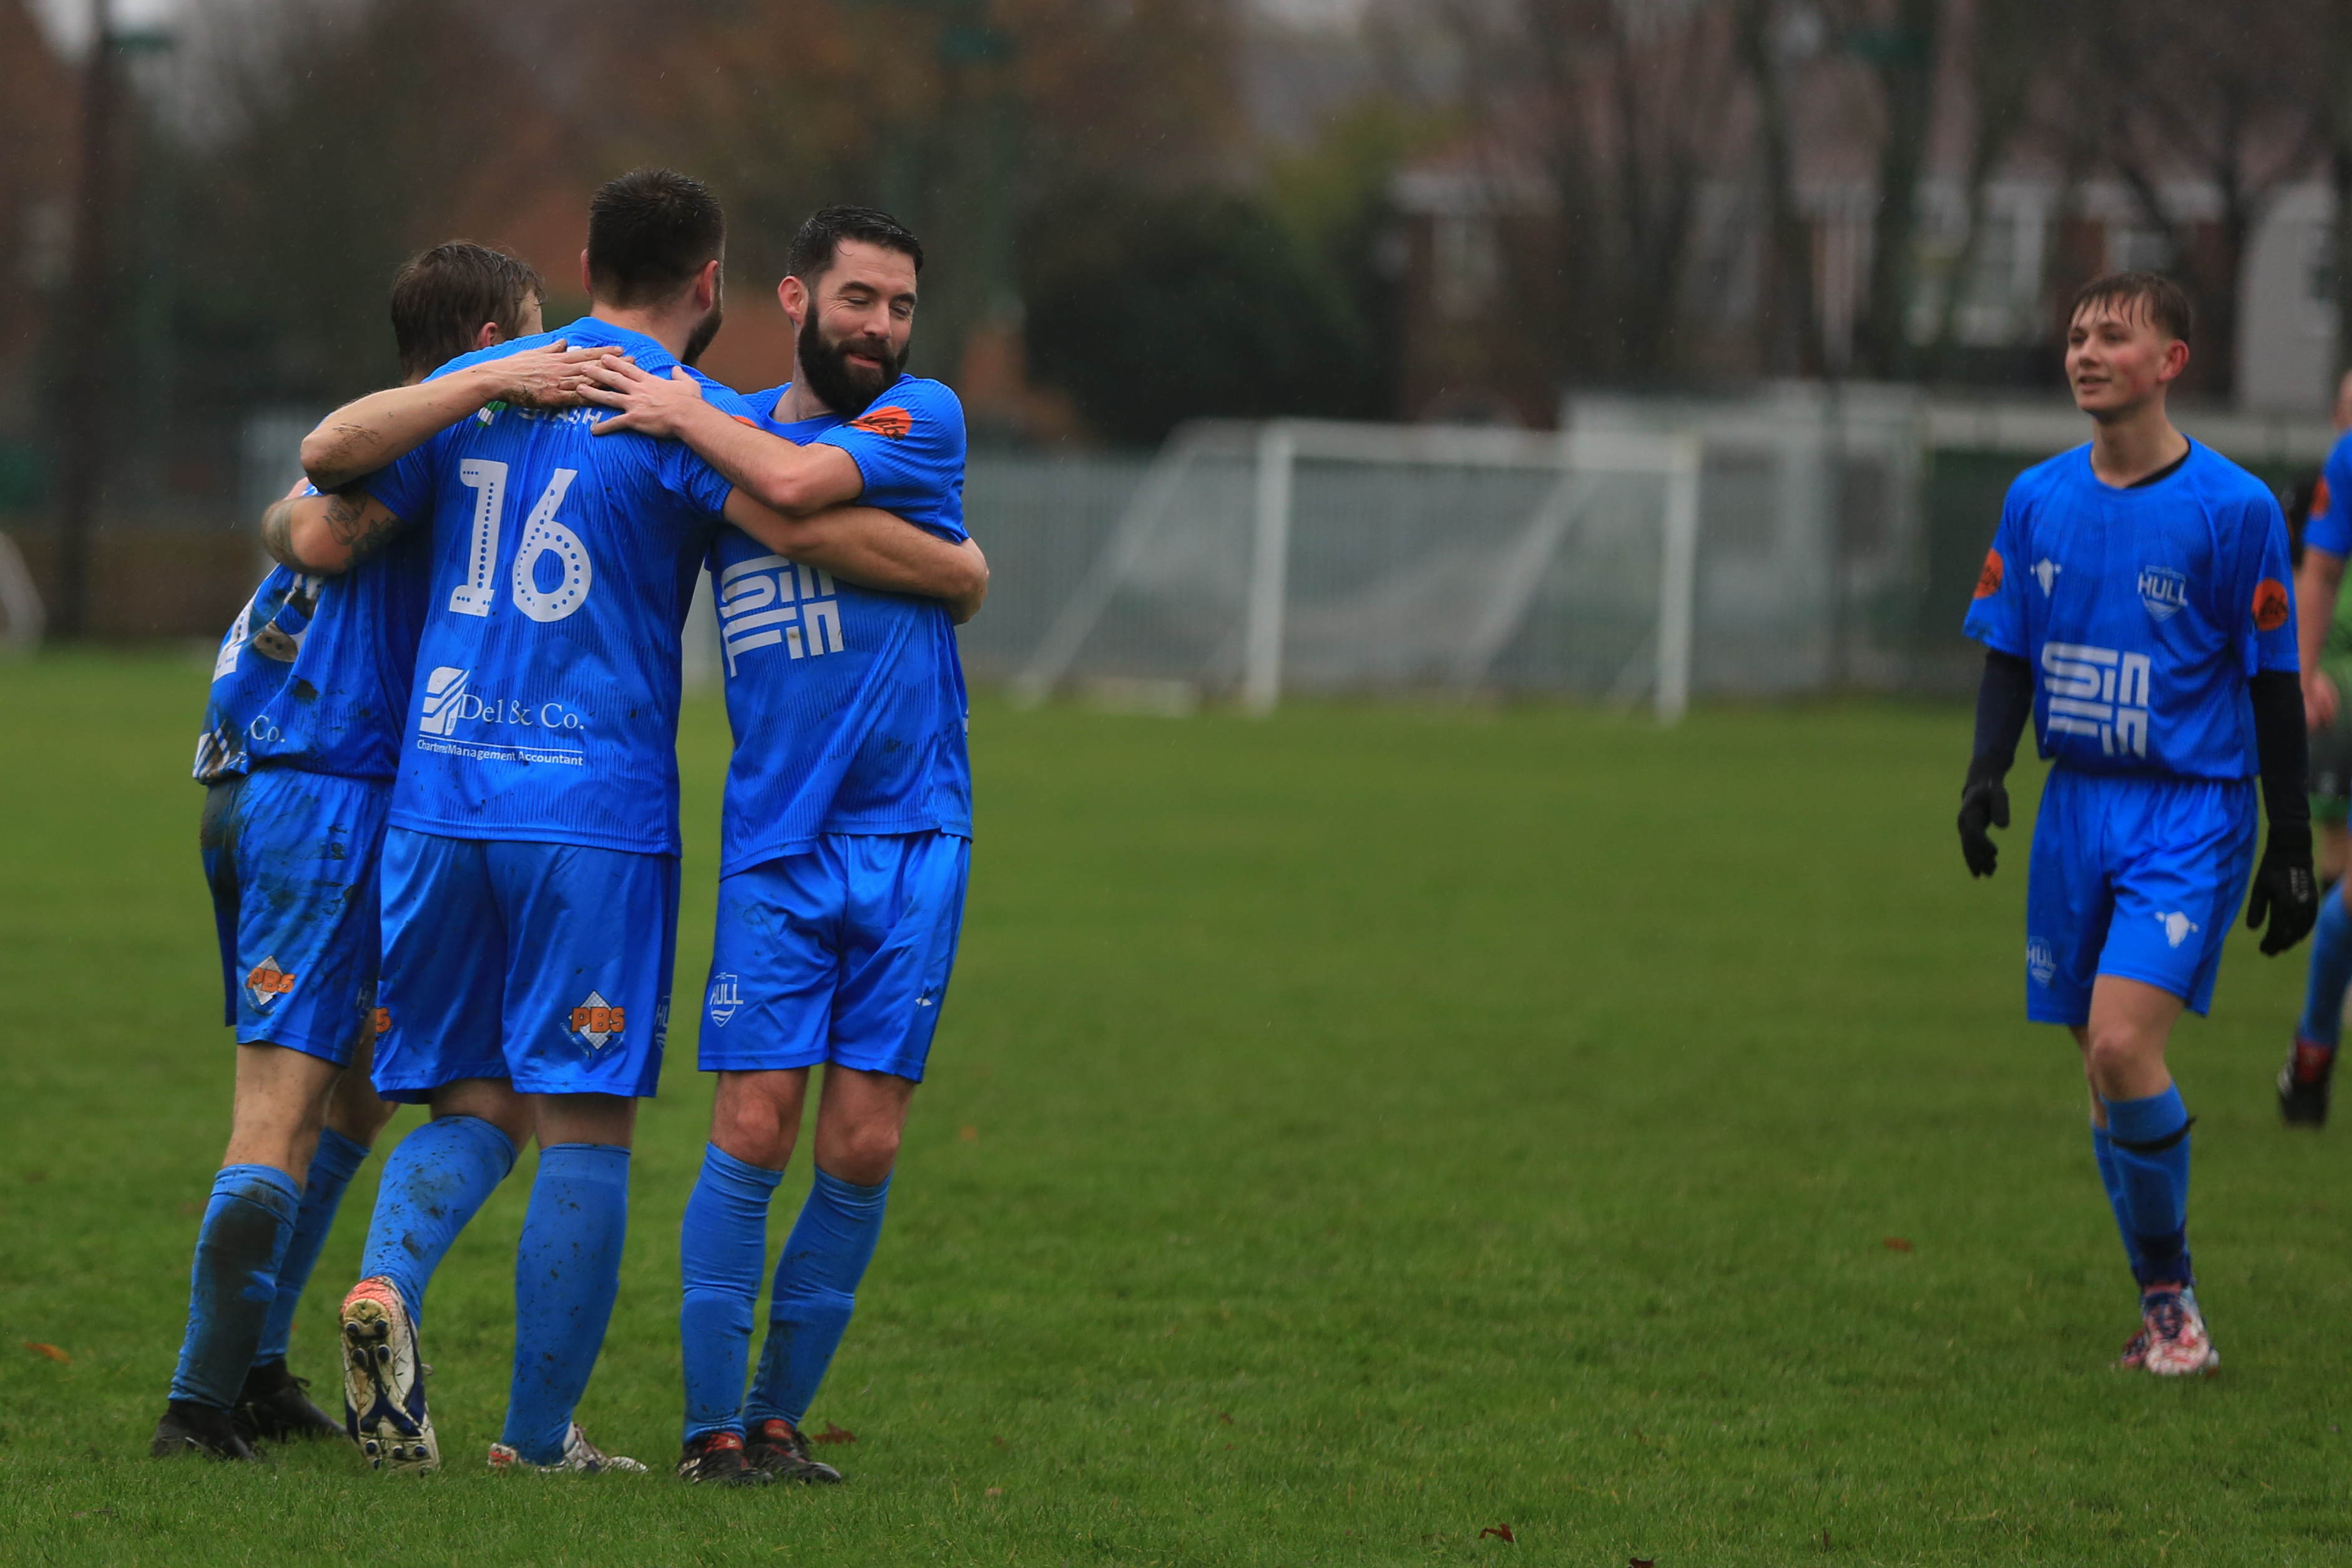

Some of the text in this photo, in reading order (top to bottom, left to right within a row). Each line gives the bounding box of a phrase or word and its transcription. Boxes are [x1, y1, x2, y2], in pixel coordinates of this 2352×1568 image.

[449, 458, 592, 622] 16
[2137, 572, 2188, 607] HULL
[458, 693, 585, 730] Del & Co.
[251, 715, 286, 743] Co.
[447, 744, 516, 761] Management
[519, 751, 584, 767] Accountant
[246, 967, 296, 994] PBS
[571, 1006, 626, 1033] PBS
